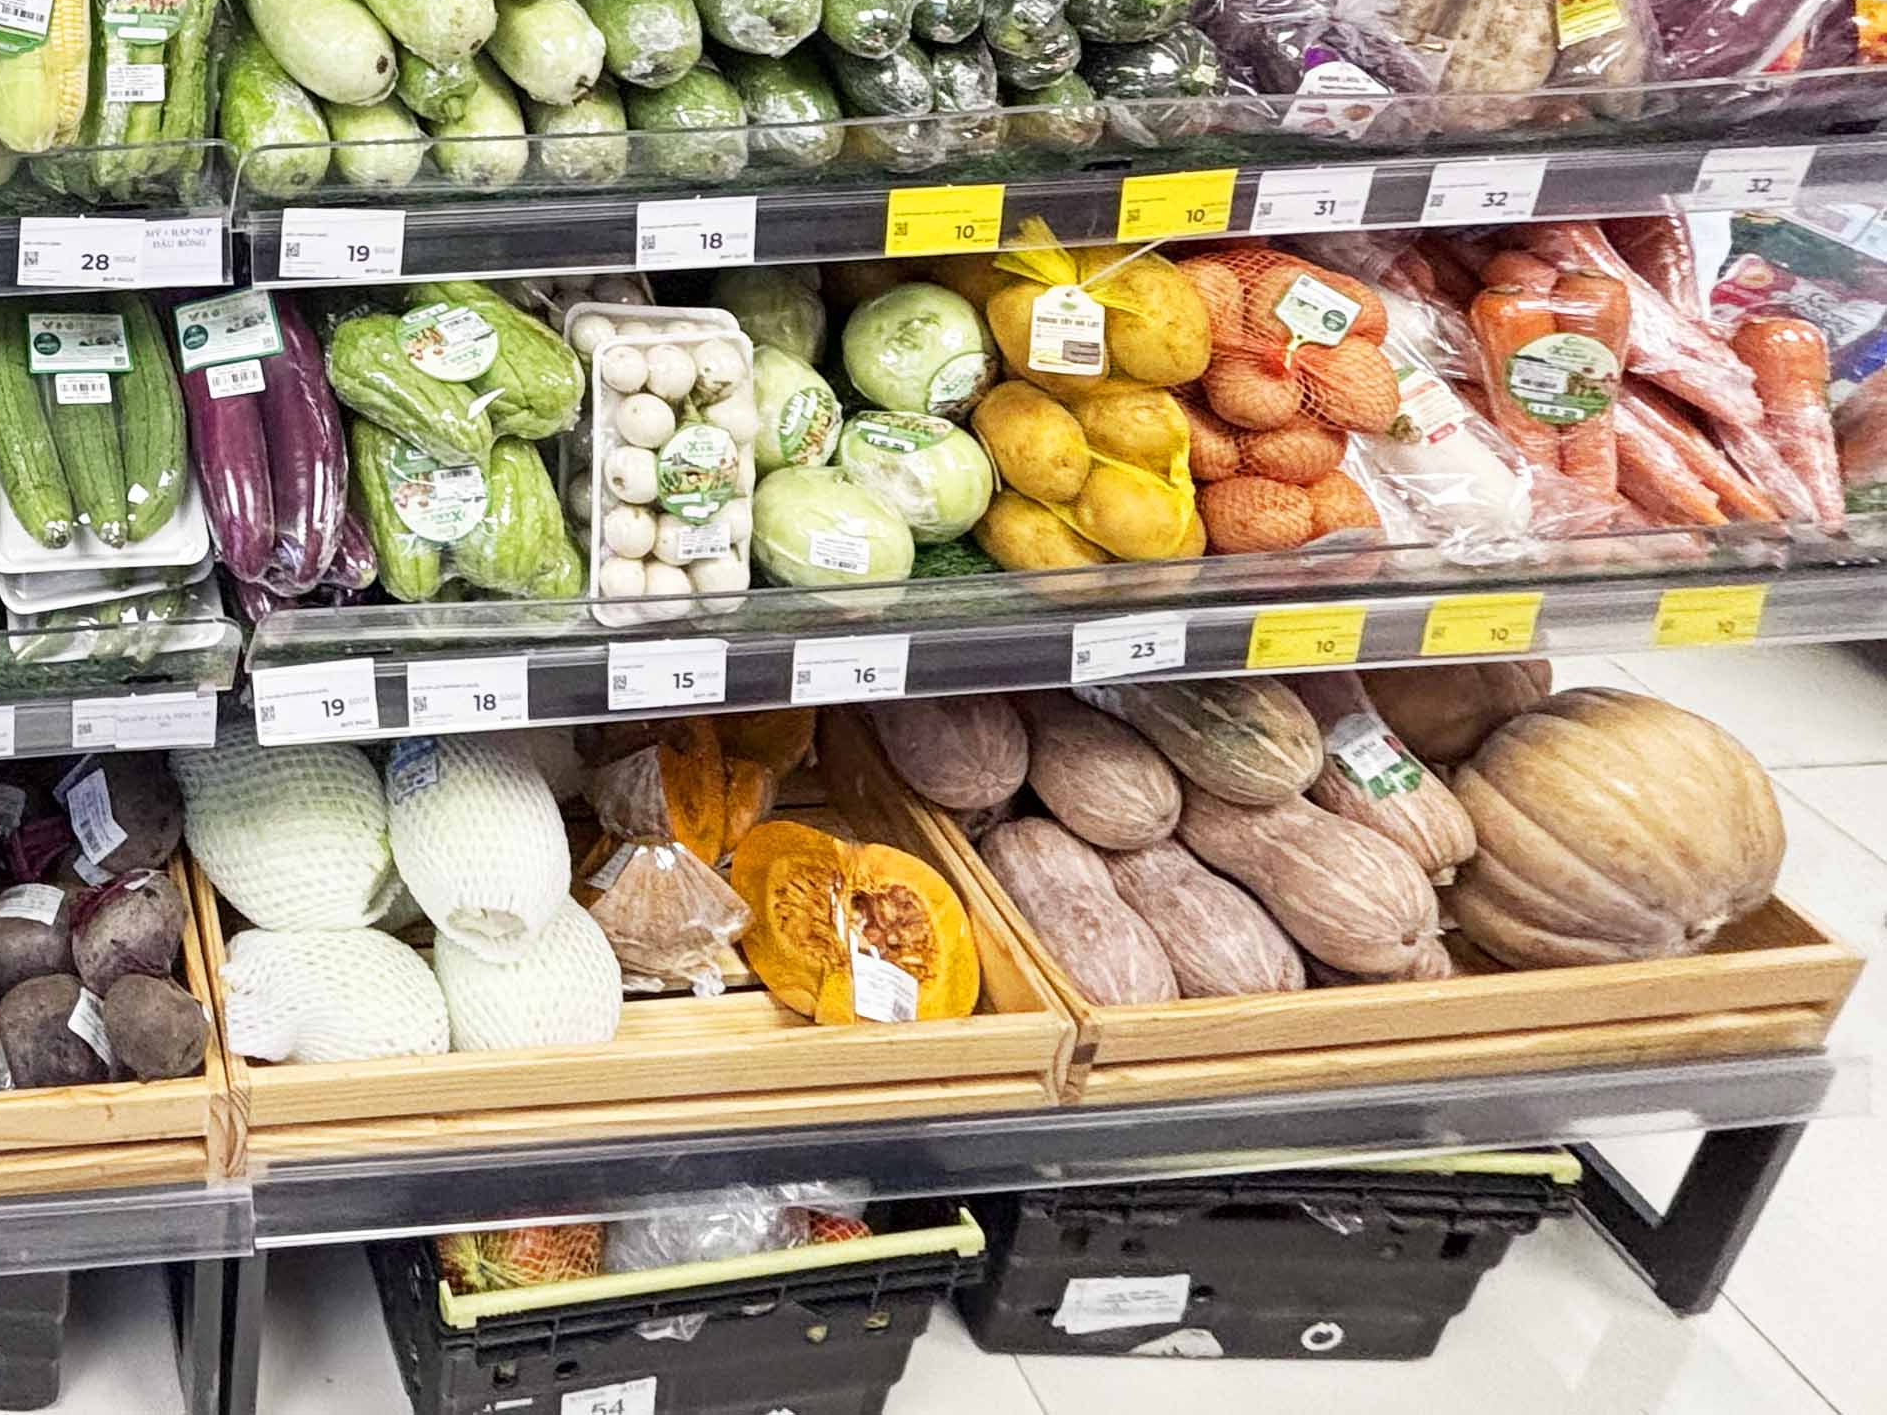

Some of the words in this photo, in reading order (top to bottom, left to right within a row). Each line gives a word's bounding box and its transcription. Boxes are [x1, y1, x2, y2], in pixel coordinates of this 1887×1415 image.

[1745, 177, 1773, 194] 32
[1313, 199, 1337, 217] 31
[1480, 191, 1509, 208] 32
[1184, 208, 1205, 224] 10
[954, 224, 975, 240] 10
[699, 232, 724, 250] 18
[80, 253, 110, 271] 28
[346, 244, 370, 263] 19
[1490, 627, 1510, 641] 10
[1130, 641, 1156, 660] 23
[1315, 639, 1336, 654] 10
[672, 672, 695, 689] 15
[853, 667, 876, 684] 16
[321, 698, 345, 718] 19
[472, 693, 497, 712] 18
[592, 1398, 624, 1415] 54
